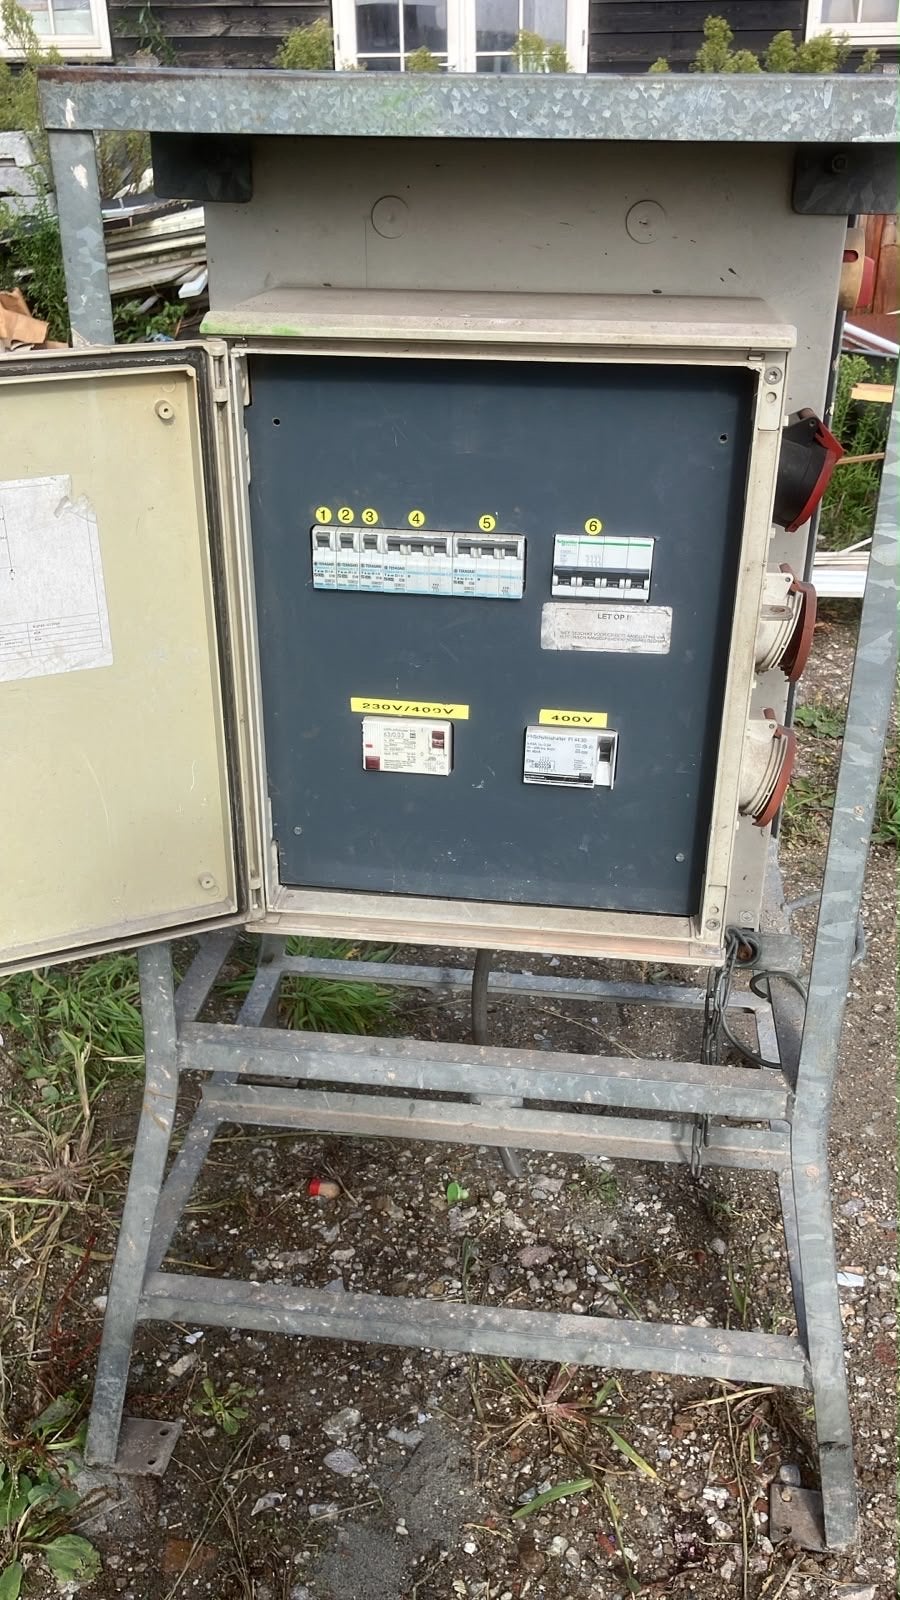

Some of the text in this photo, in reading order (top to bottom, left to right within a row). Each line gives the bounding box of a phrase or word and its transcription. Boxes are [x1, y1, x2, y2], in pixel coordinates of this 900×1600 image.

[320, 511, 325, 520] 1
[342, 510, 350, 521] 2
[366, 511, 373, 522] 3
[412, 513, 420, 524] 4
[483, 518, 491, 528] 5
[589, 521, 597, 531] 6
[362, 702, 454, 714] 230V/400V
[551, 715, 593, 723] 400V
